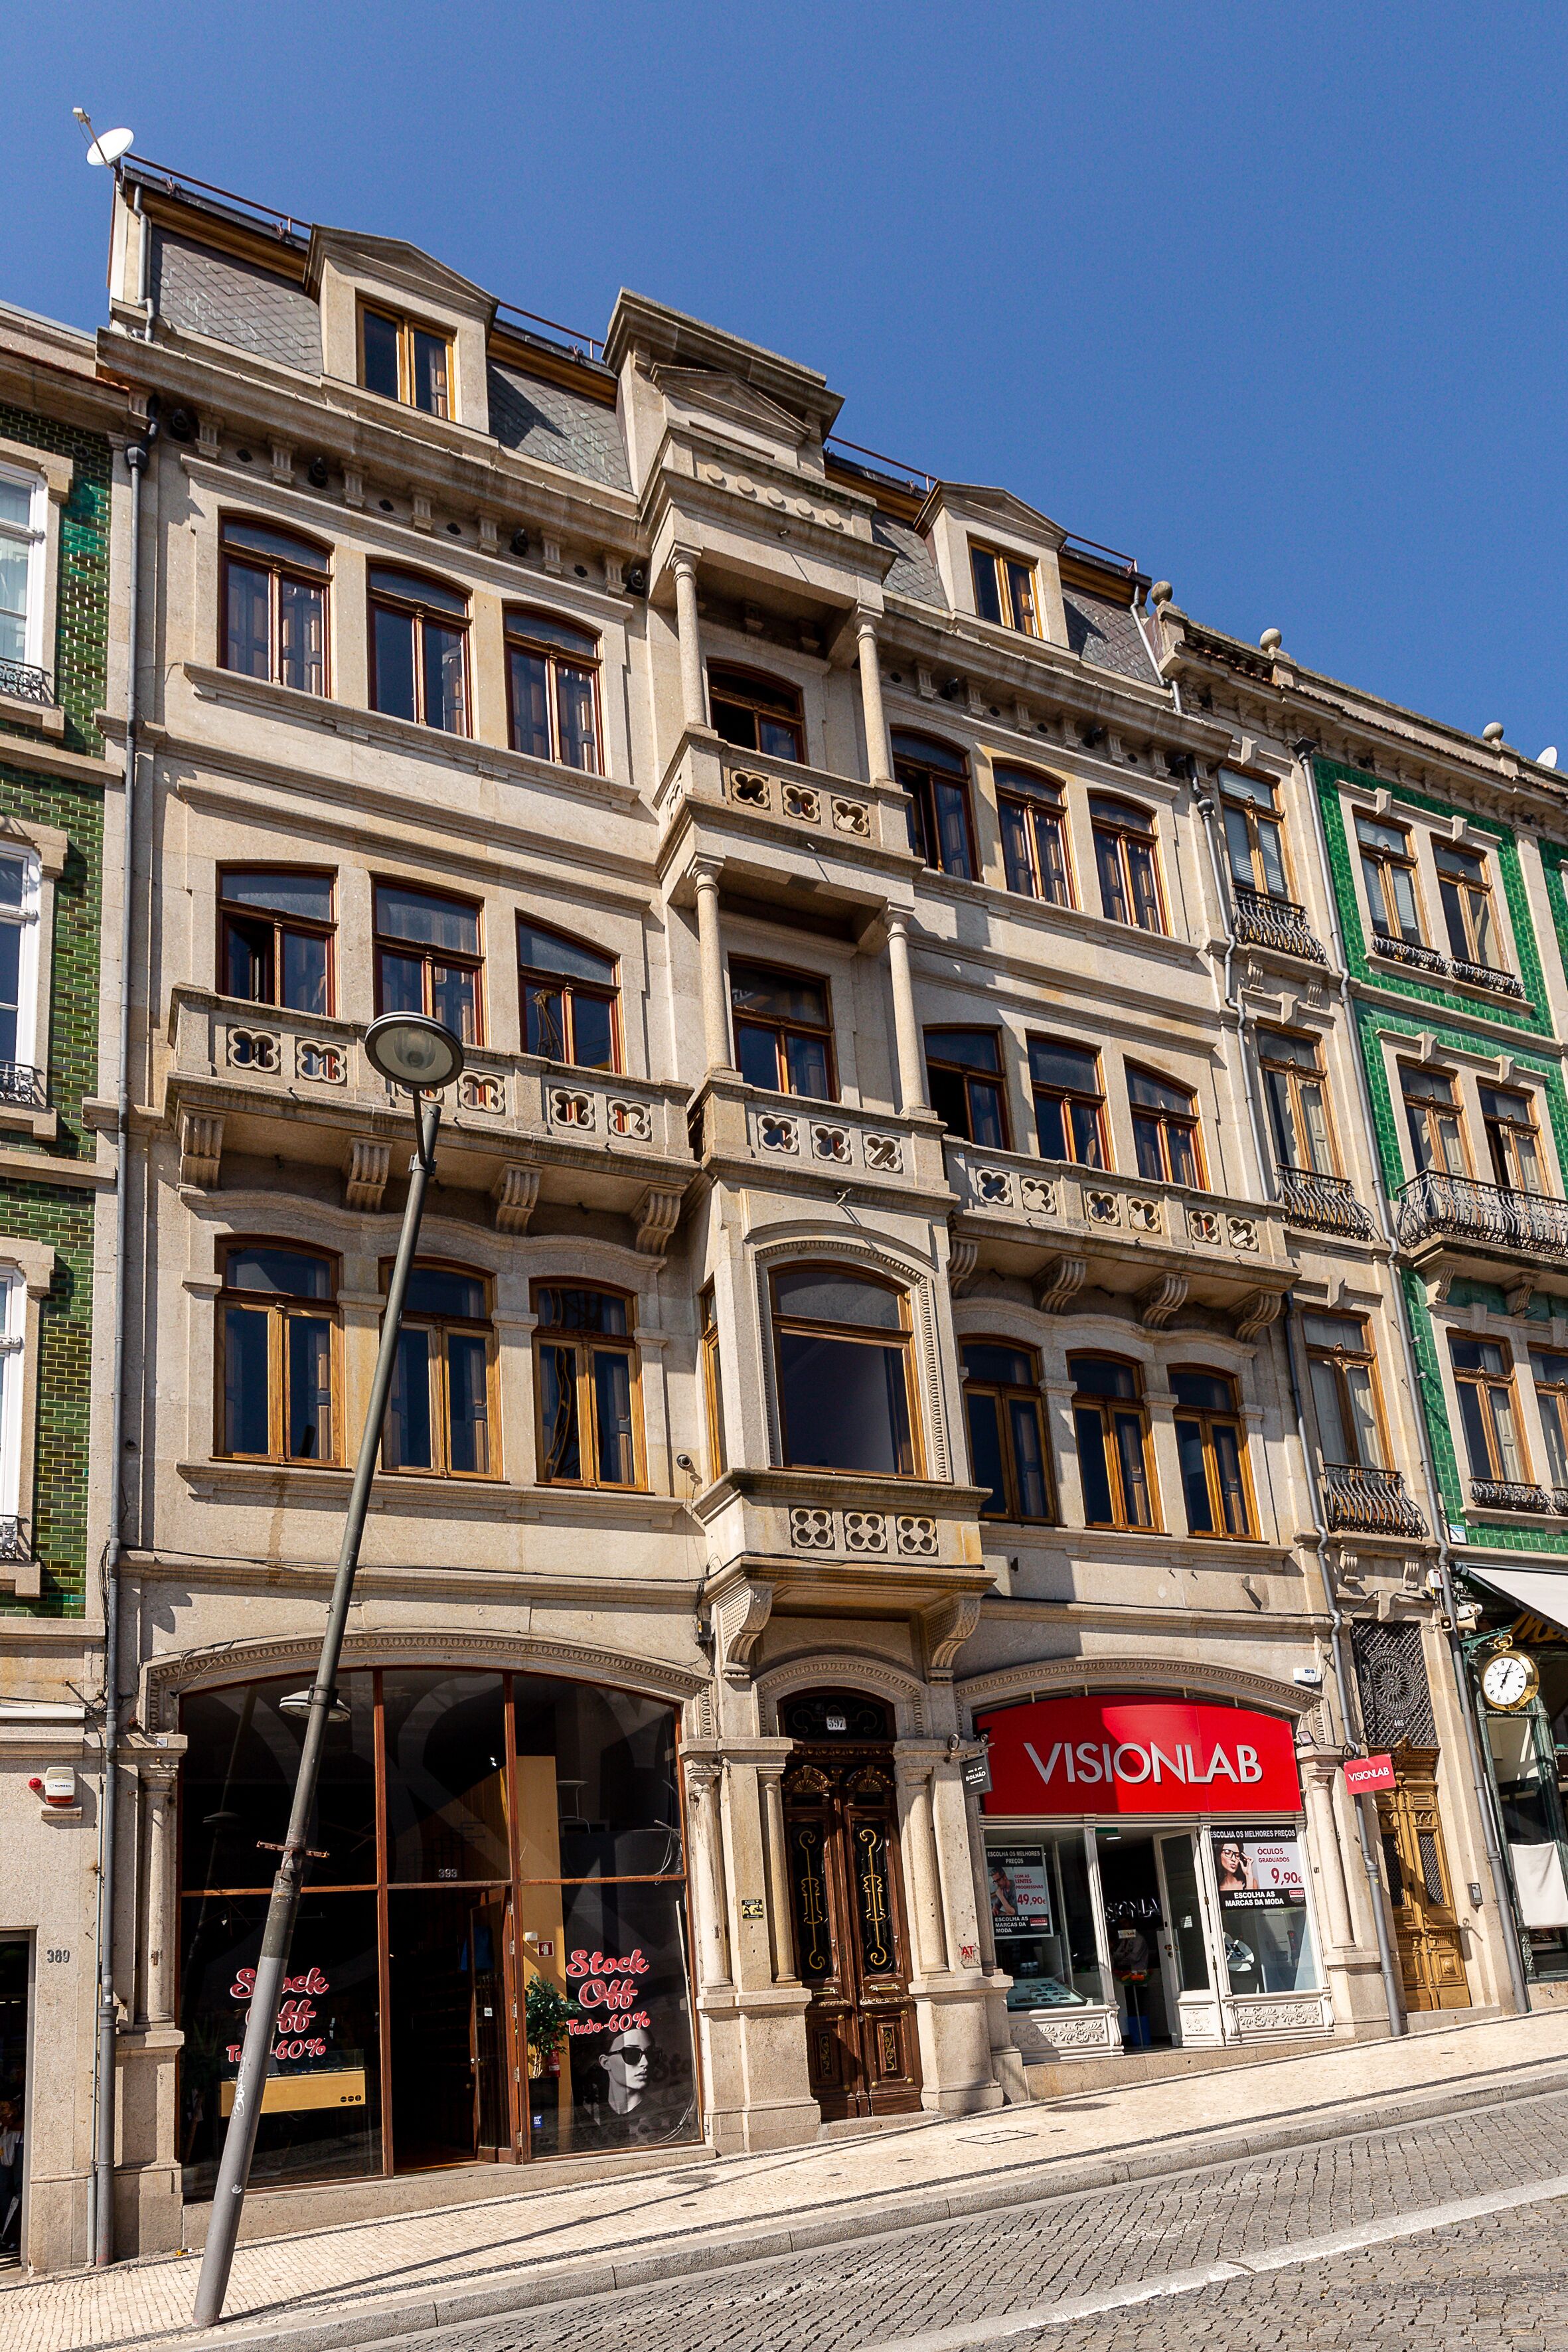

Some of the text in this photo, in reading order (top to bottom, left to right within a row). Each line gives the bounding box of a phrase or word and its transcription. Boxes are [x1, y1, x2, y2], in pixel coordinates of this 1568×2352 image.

[828, 1718, 844, 1728] 397
[1023, 1742, 1263, 1784] VISIONLAB
[1348, 1767, 1389, 1782] VISIONLAB
[1275, 1830, 1296, 1838] PREÇOS
[1257, 1847, 1284, 1855] ÓCULOS
[438, 1869, 457, 1878] 393
[1017, 1893, 1046, 1906] 49,90€
[46, 1950, 70, 1963] 389
[961, 1946, 974, 1955] AT
[566, 1949, 650, 1978] Stock
[230, 1968, 329, 1999] Sock
[578, 1979, 638, 2009] Off
[245, 1999, 317, 2033] ff
